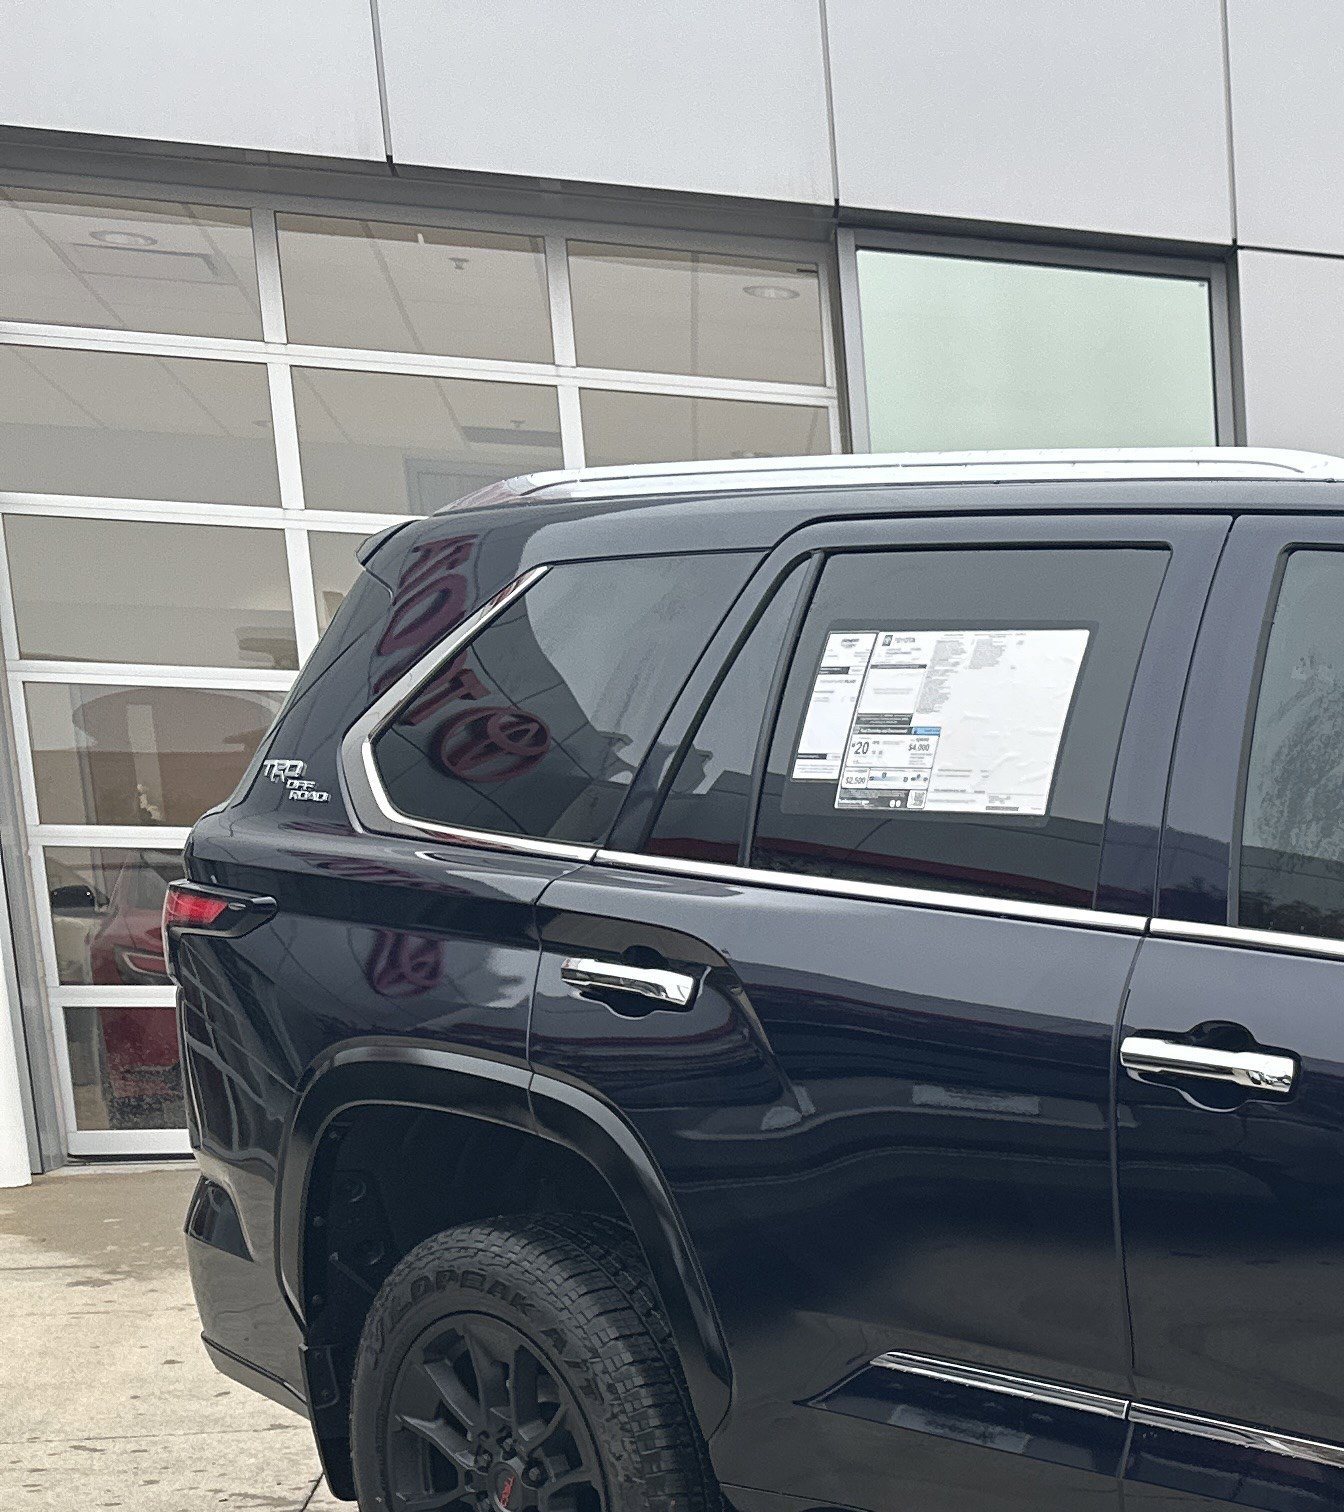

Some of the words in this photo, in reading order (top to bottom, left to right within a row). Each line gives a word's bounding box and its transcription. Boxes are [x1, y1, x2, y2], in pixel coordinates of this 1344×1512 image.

[854, 741, 870, 755] 20
[263, 759, 306, 783] TRD
[286, 779, 316, 791] OFF
[289, 789, 331, 802] ROAD
